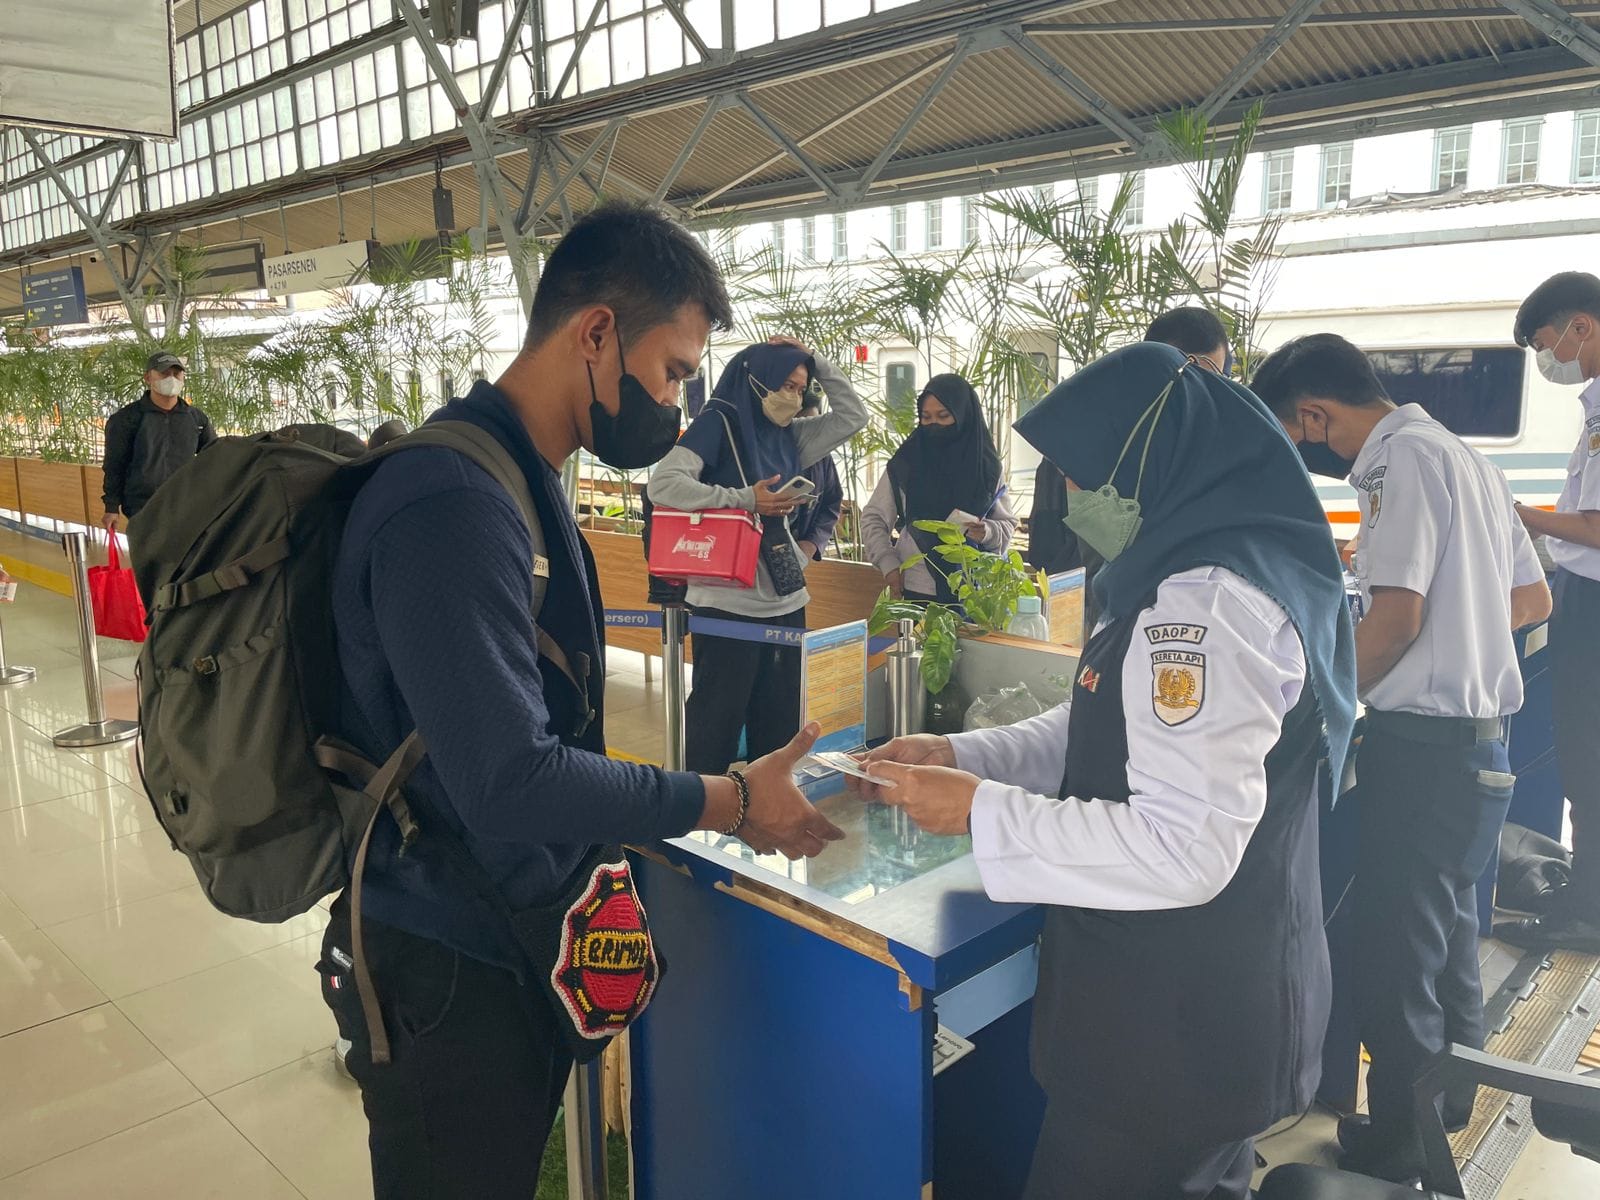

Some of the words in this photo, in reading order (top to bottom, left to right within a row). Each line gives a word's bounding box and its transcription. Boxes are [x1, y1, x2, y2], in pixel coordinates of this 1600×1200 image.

[267, 257, 317, 279] PASARSENEN
[604, 614, 649, 625] ersero)
[766, 629, 782, 640] PT
[785, 631, 802, 643] KA
[1151, 627, 1189, 640] DAOP
[1193, 629, 1201, 640] 1
[1154, 652, 1182, 662] KERETA
[1184, 654, 1201, 663] API
[937, 1032, 963, 1050] Lenovo
